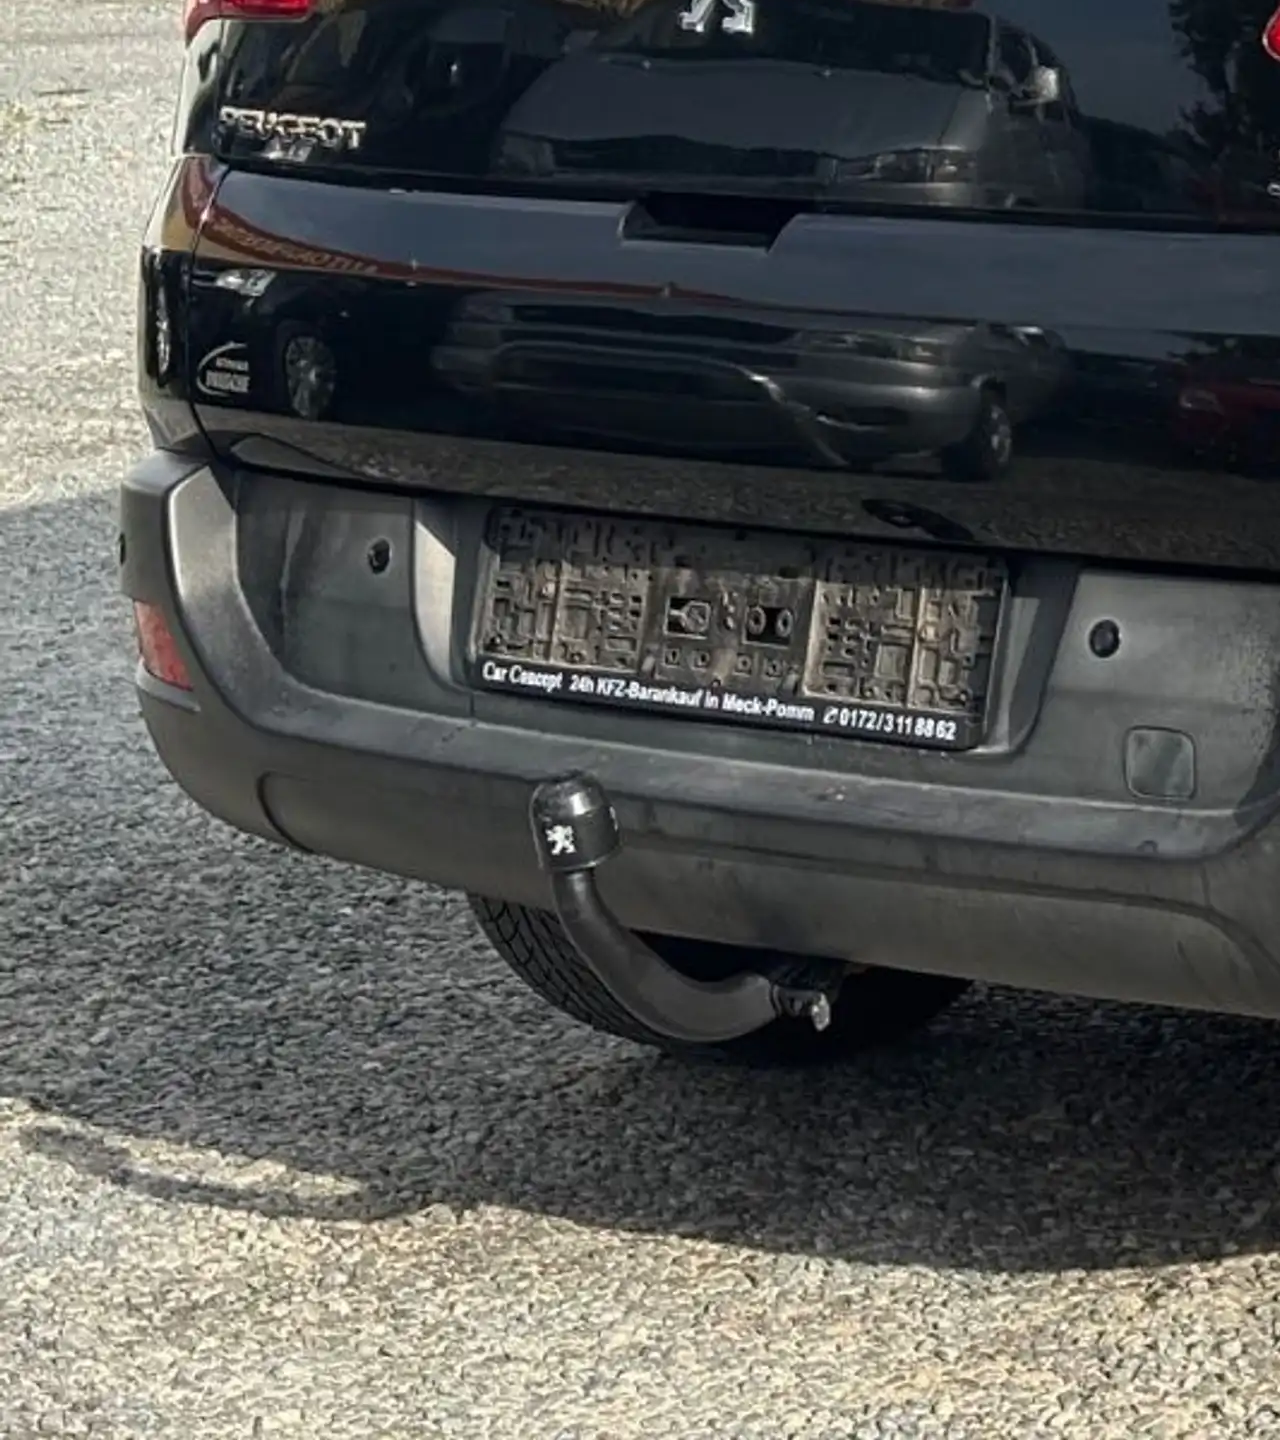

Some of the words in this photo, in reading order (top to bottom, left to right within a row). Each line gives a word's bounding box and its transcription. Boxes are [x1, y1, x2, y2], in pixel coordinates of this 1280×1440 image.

[220, 105, 366, 150] PEUGEOT
[481, 661, 508, 682] Car
[568, 674, 594, 694] 24h
[703, 689, 720, 709] in
[721, 692, 815, 722] Meck-Pomm
